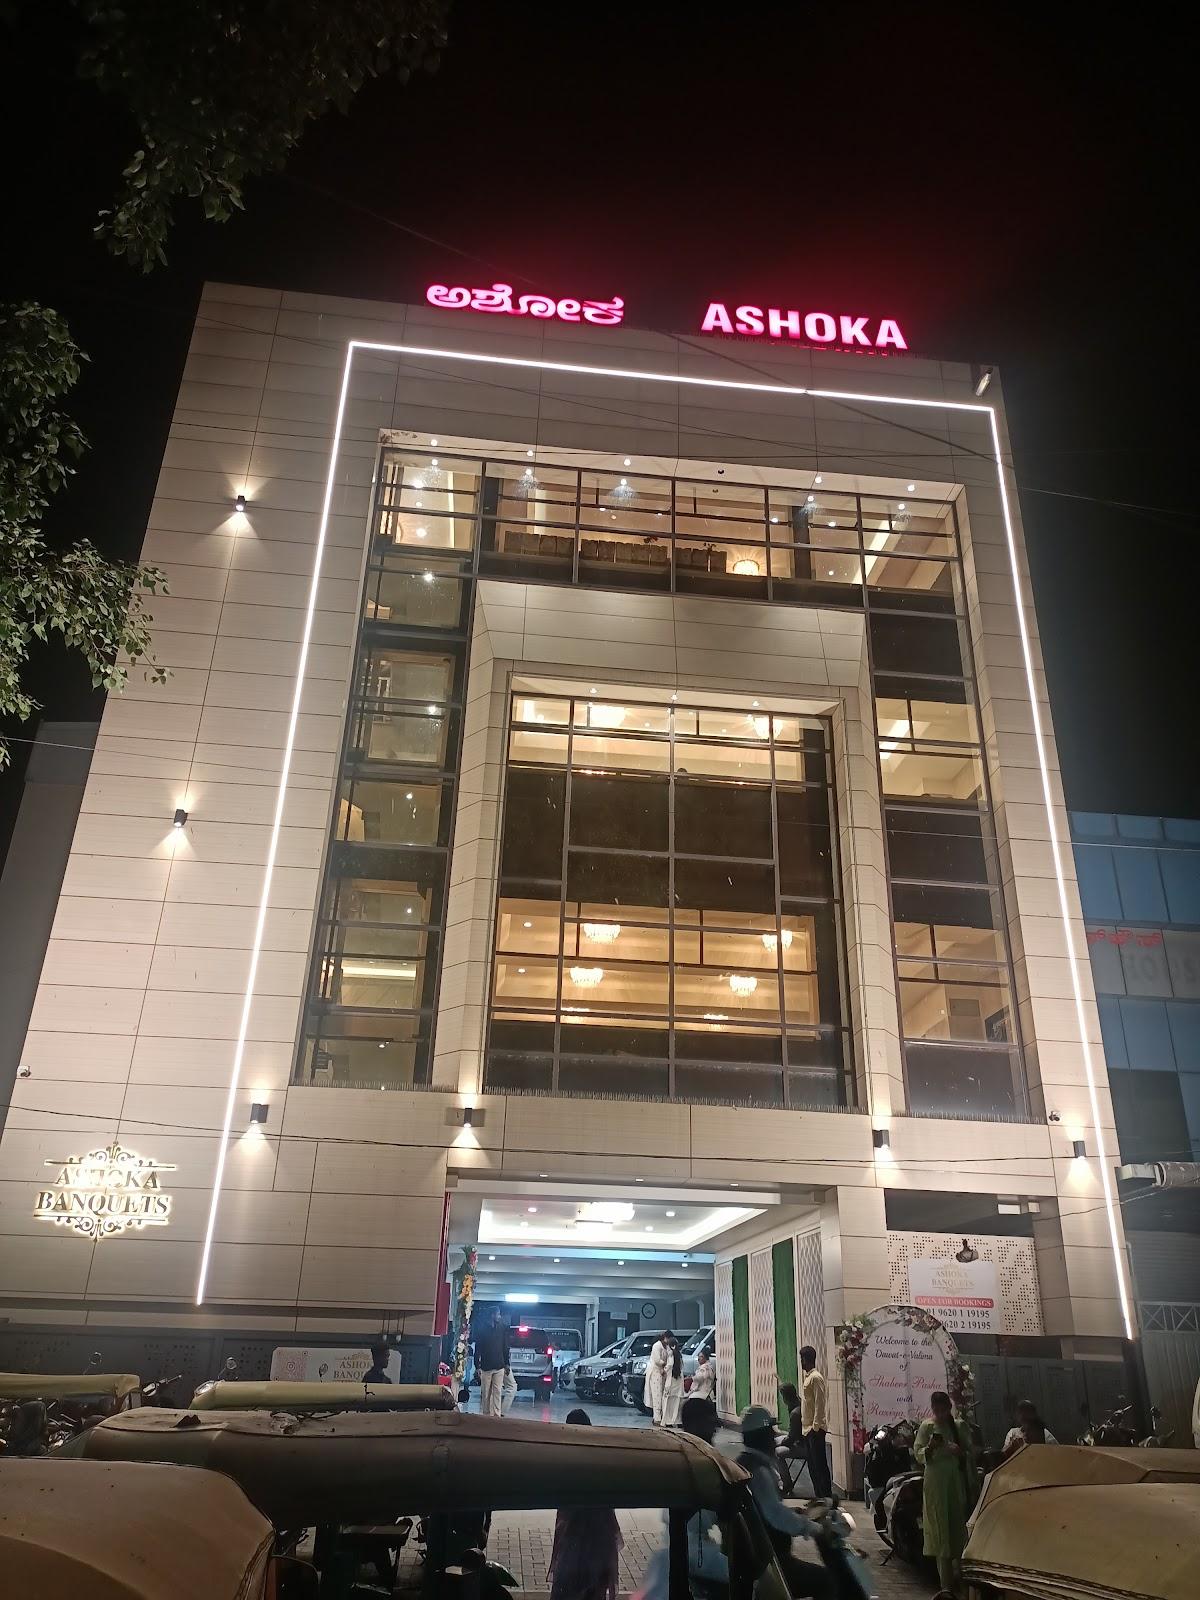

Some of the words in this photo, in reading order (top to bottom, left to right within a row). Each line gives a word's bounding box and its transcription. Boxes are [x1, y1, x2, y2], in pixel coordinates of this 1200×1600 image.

[426, 283, 625, 325] ಅಶೋಕ
[701, 303, 909, 349] ASHOKA
[37, 1191, 169, 1216] BANQUETS
[917, 1296, 937, 1304] OPEN
[939, 1297, 953, 1305] FOR
[954, 1298, 992, 1307] BOOKINGS
[938, 1308, 957, 1317] 9620
[960, 1309, 964, 1317] 1
[967, 1309, 990, 1318] 19195
[961, 1321, 966, 1329] 2
[968, 1321, 991, 1330] 19195
[875, 1335, 909, 1345] Welcome
[911, 1338, 919, 1346] to
[920, 1336, 933, 1347] the
[899, 1361, 909, 1371] of
[896, 1394, 913, 1403] with
